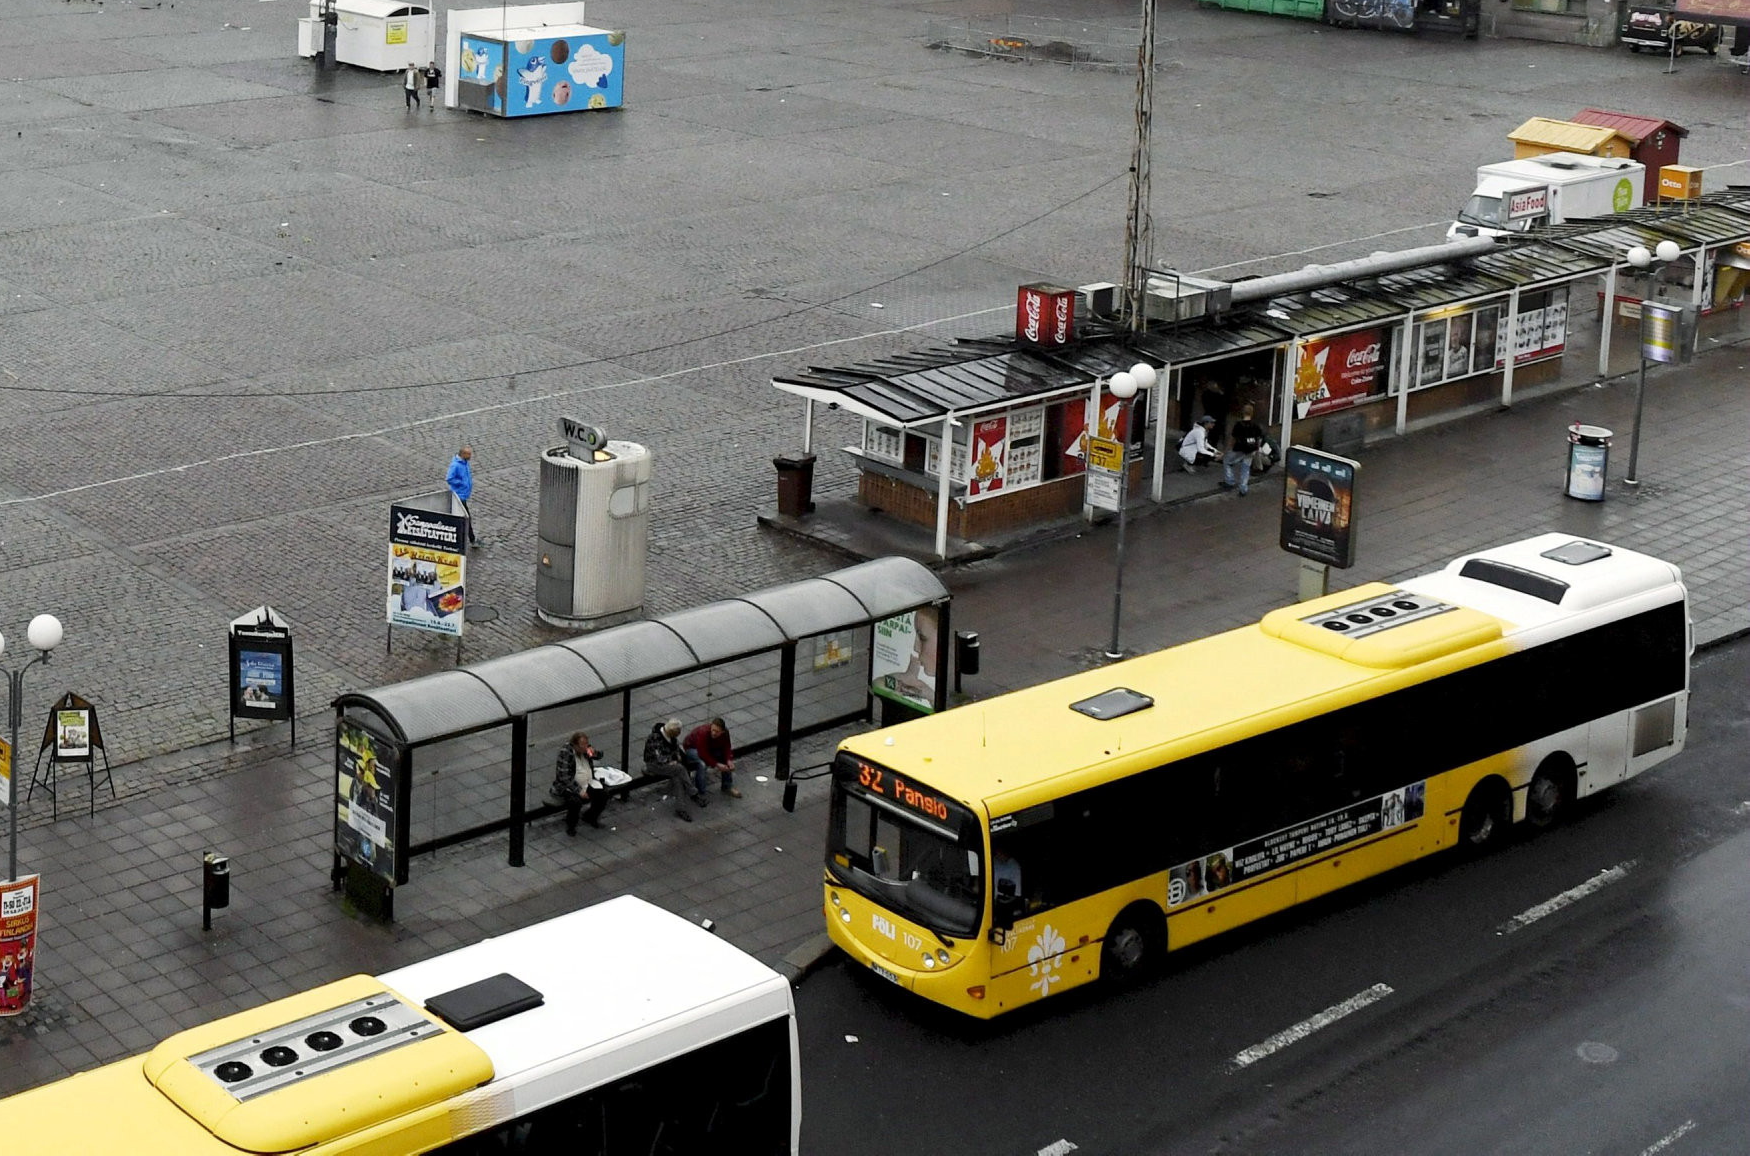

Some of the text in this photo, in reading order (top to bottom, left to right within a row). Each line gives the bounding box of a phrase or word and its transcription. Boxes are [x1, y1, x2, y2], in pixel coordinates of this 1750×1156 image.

[1662, 178, 1681, 189] Otto
[1024, 291, 1041, 342] Coca-Cola
[1054, 296, 1068, 344] Coca-Cola
[1347, 343, 1381, 368] Coca-Cola
[563, 421, 587, 443] W.C.
[1097, 455, 1107, 467] 37
[877, 625, 893, 639] SIIN
[858, 761, 948, 820] 32 Pansio
[902, 931, 922, 951] 107
